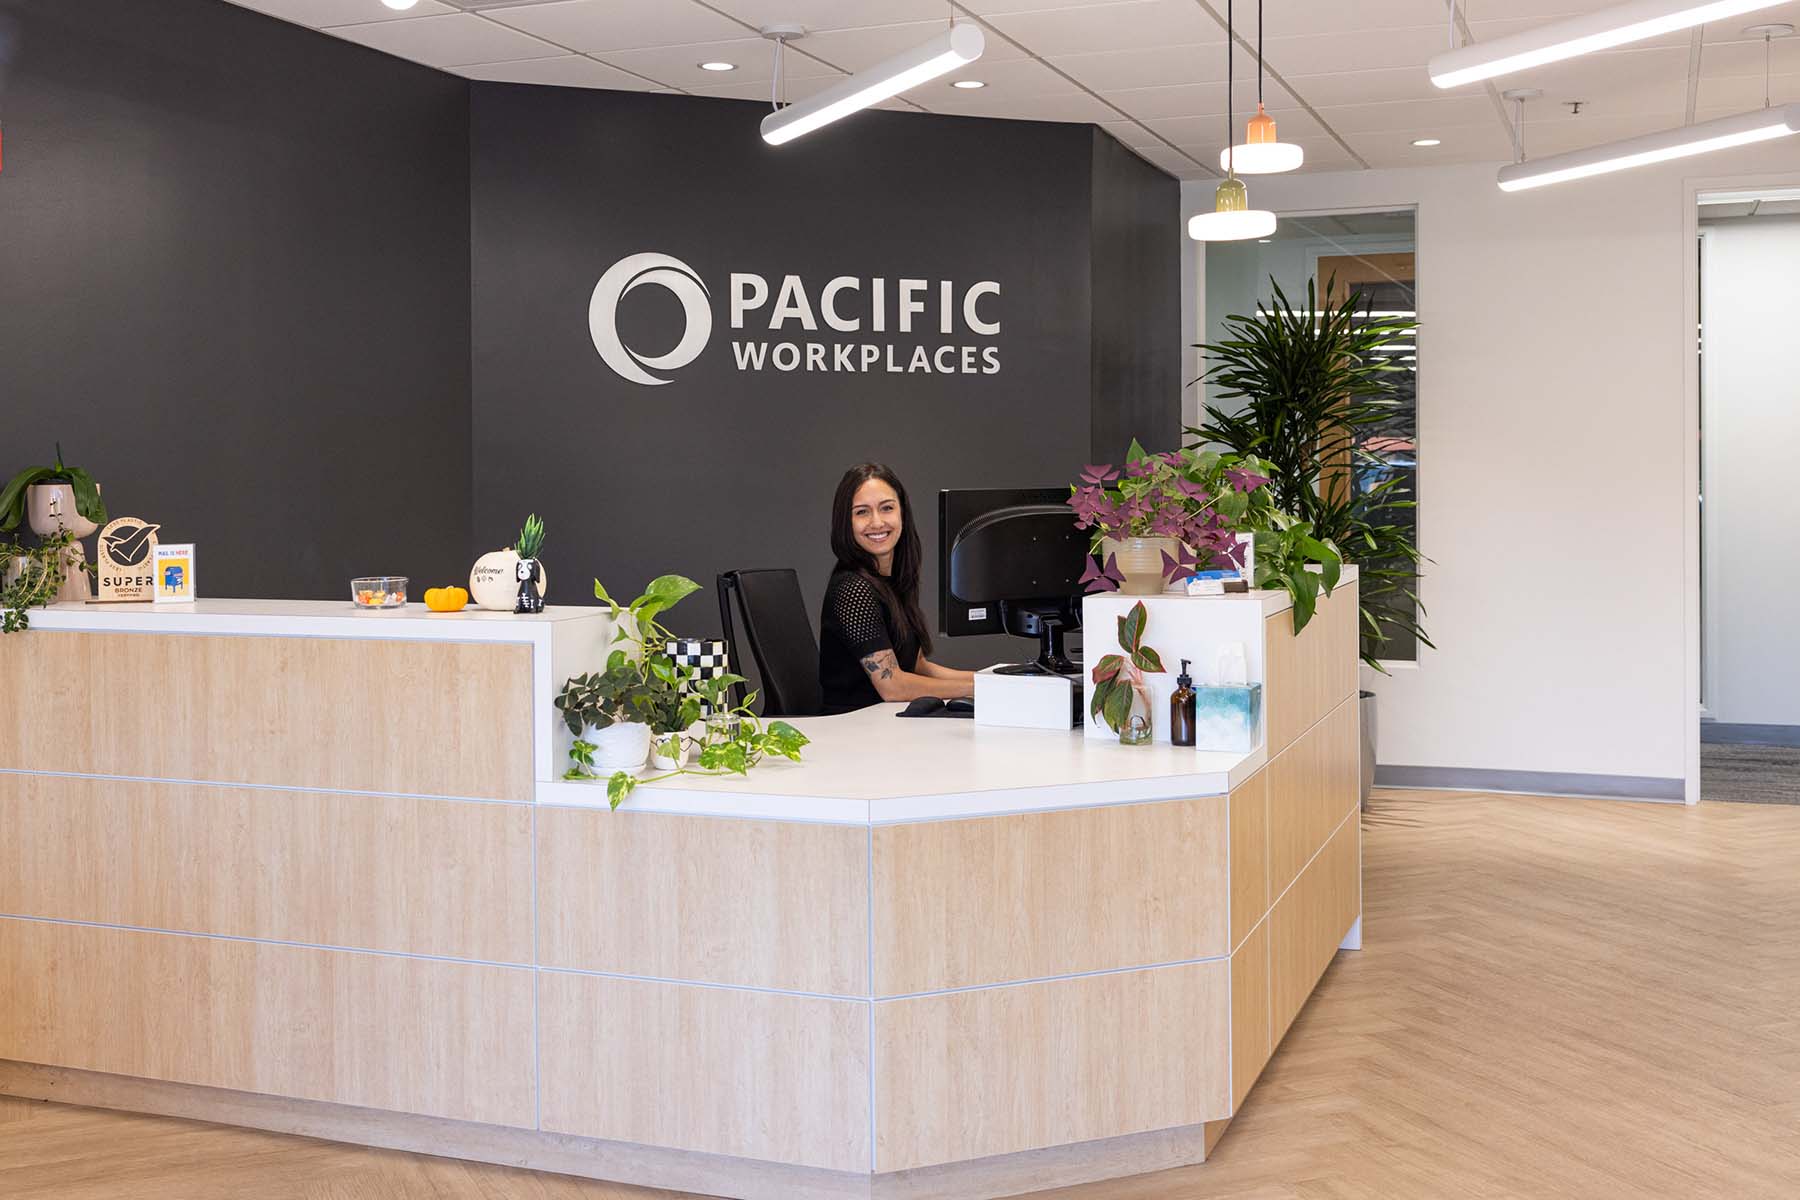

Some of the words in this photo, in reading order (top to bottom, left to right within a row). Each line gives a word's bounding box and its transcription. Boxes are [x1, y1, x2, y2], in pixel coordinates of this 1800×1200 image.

[730, 272, 1001, 335] PACIFIC
[731, 341, 1001, 375] WORKPLACES
[103, 576, 153, 586] SUPER
[474, 566, 504, 575] Welcome
